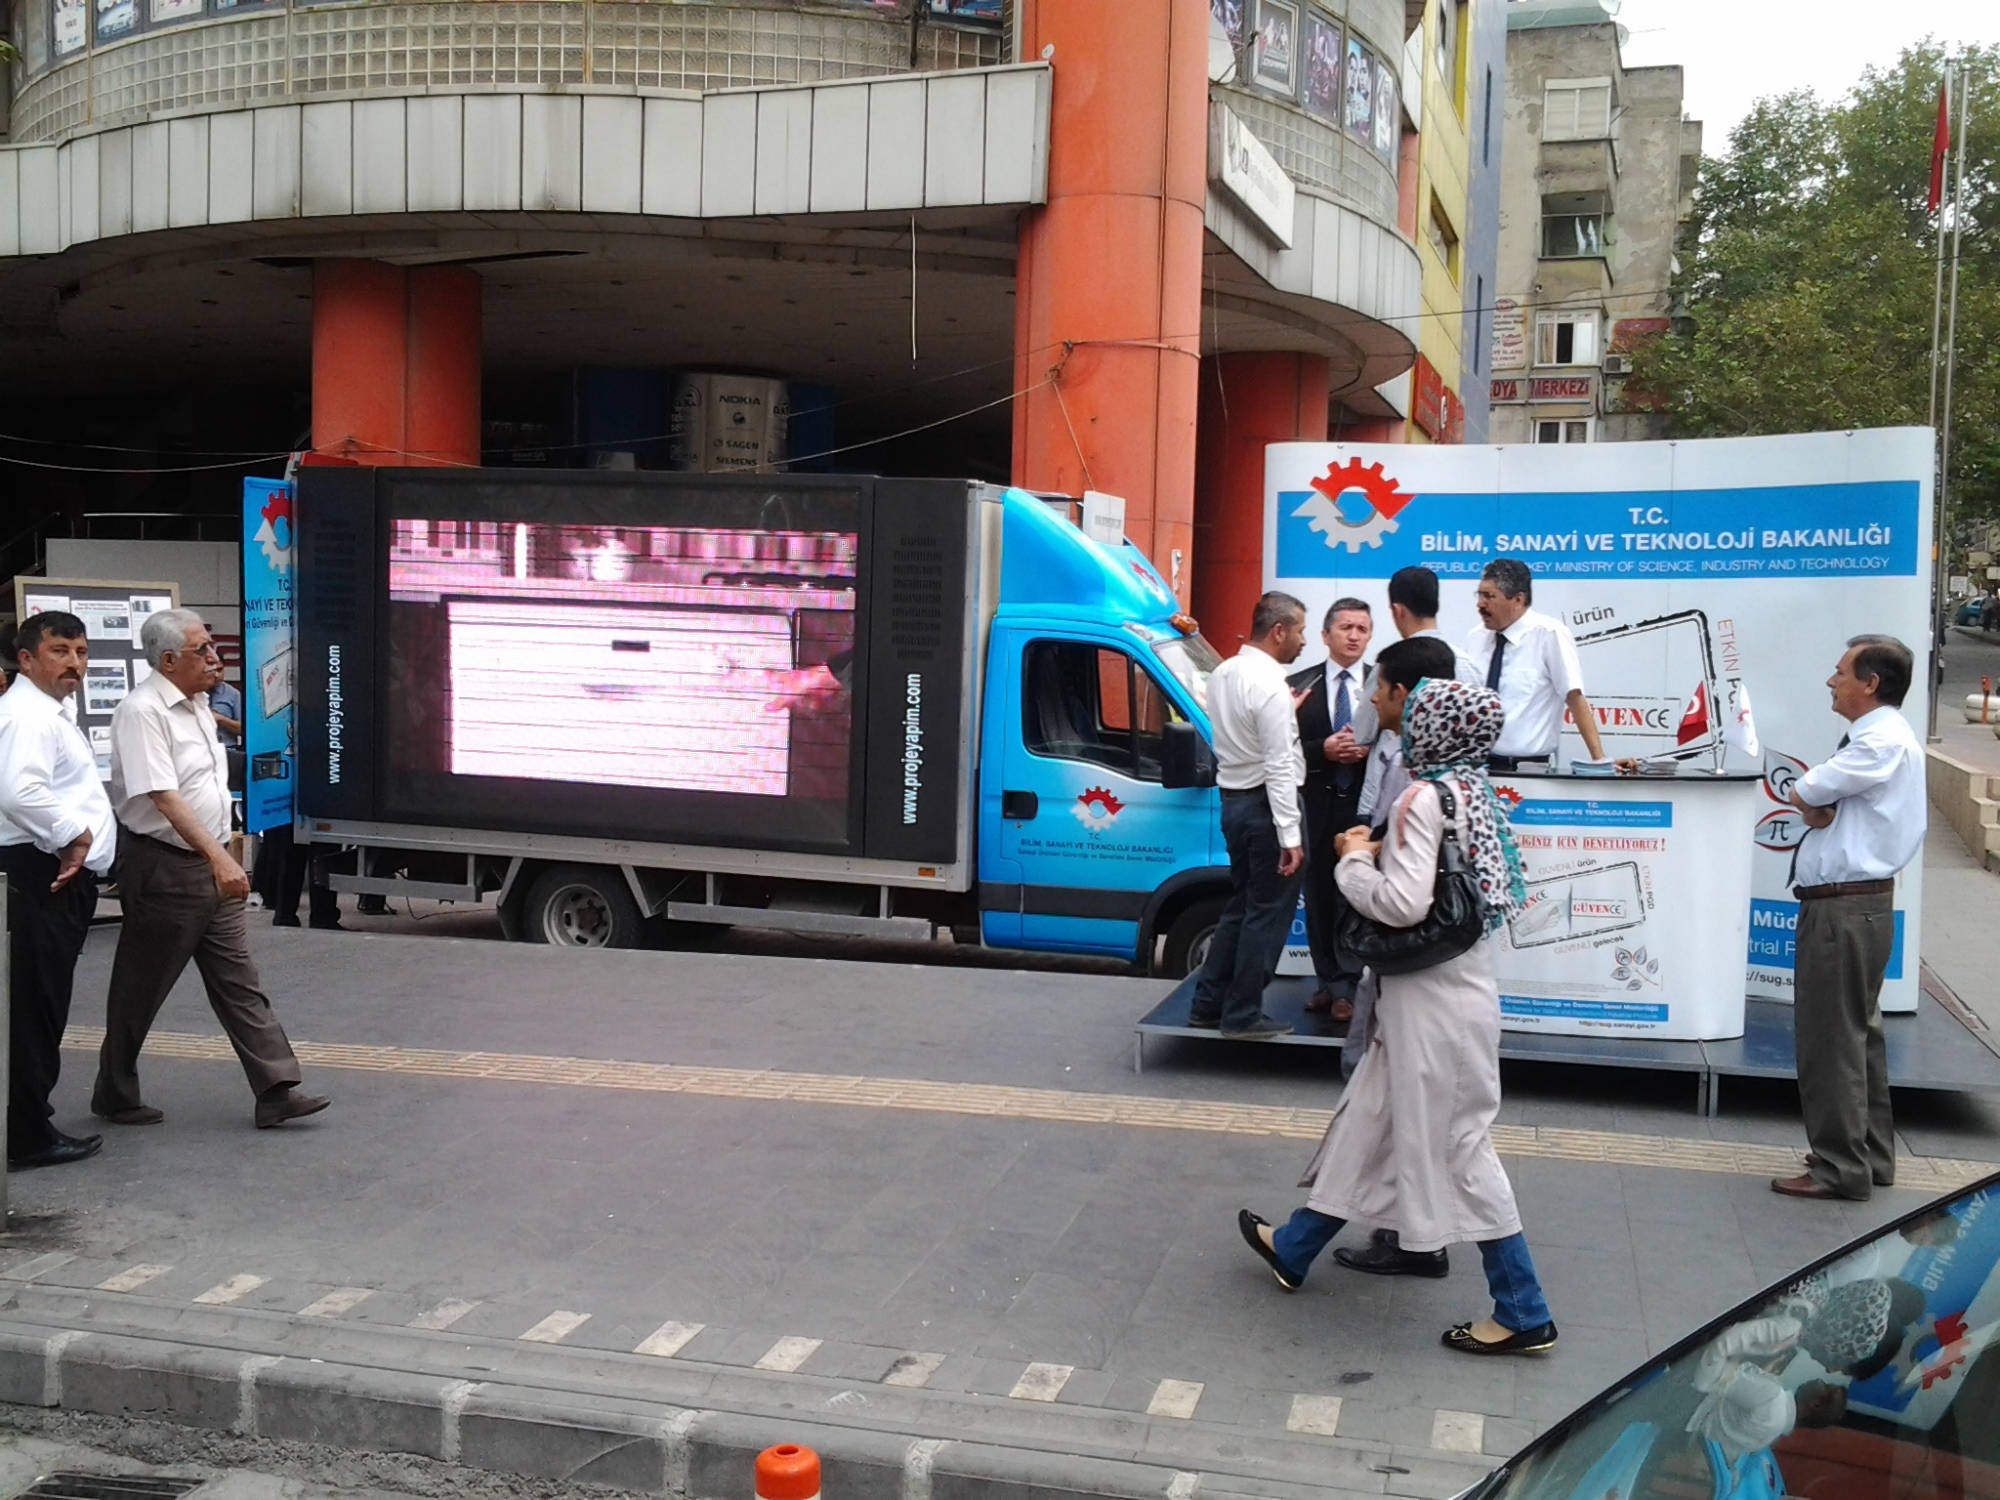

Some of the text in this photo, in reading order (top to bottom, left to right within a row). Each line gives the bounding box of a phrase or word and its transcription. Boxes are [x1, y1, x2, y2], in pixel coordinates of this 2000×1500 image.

[1493, 381, 1517, 398] DYA
[719, 394, 761, 406] NOKIA
[1628, 507, 1669, 525] T.C.
[1421, 523, 1891, 555] BİLİM, SANAYİ VE TEKNOLOJİ BAKANLIĞI
[1527, 561, 1551, 573] KEY
[1555, 561, 1612, 573] MINISTRY
[1617, 561, 1634, 572] OF
[1702, 559, 1765, 572] INDUSTRY
[1768, 558, 1796, 571] AND
[1800, 556, 1890, 570] TECHNOLOGY
[245, 596, 294, 612] NAYİ VE TEK
[1572, 606, 1615, 626] ürün
[1717, 618, 1741, 673] ETKİN
[325, 644, 344, 784] www.projeyapim.com
[901, 673, 924, 824] www.projeyapim.com
[1577, 859, 1597, 868] ürün
[1753, 909, 1797, 930] Müd
